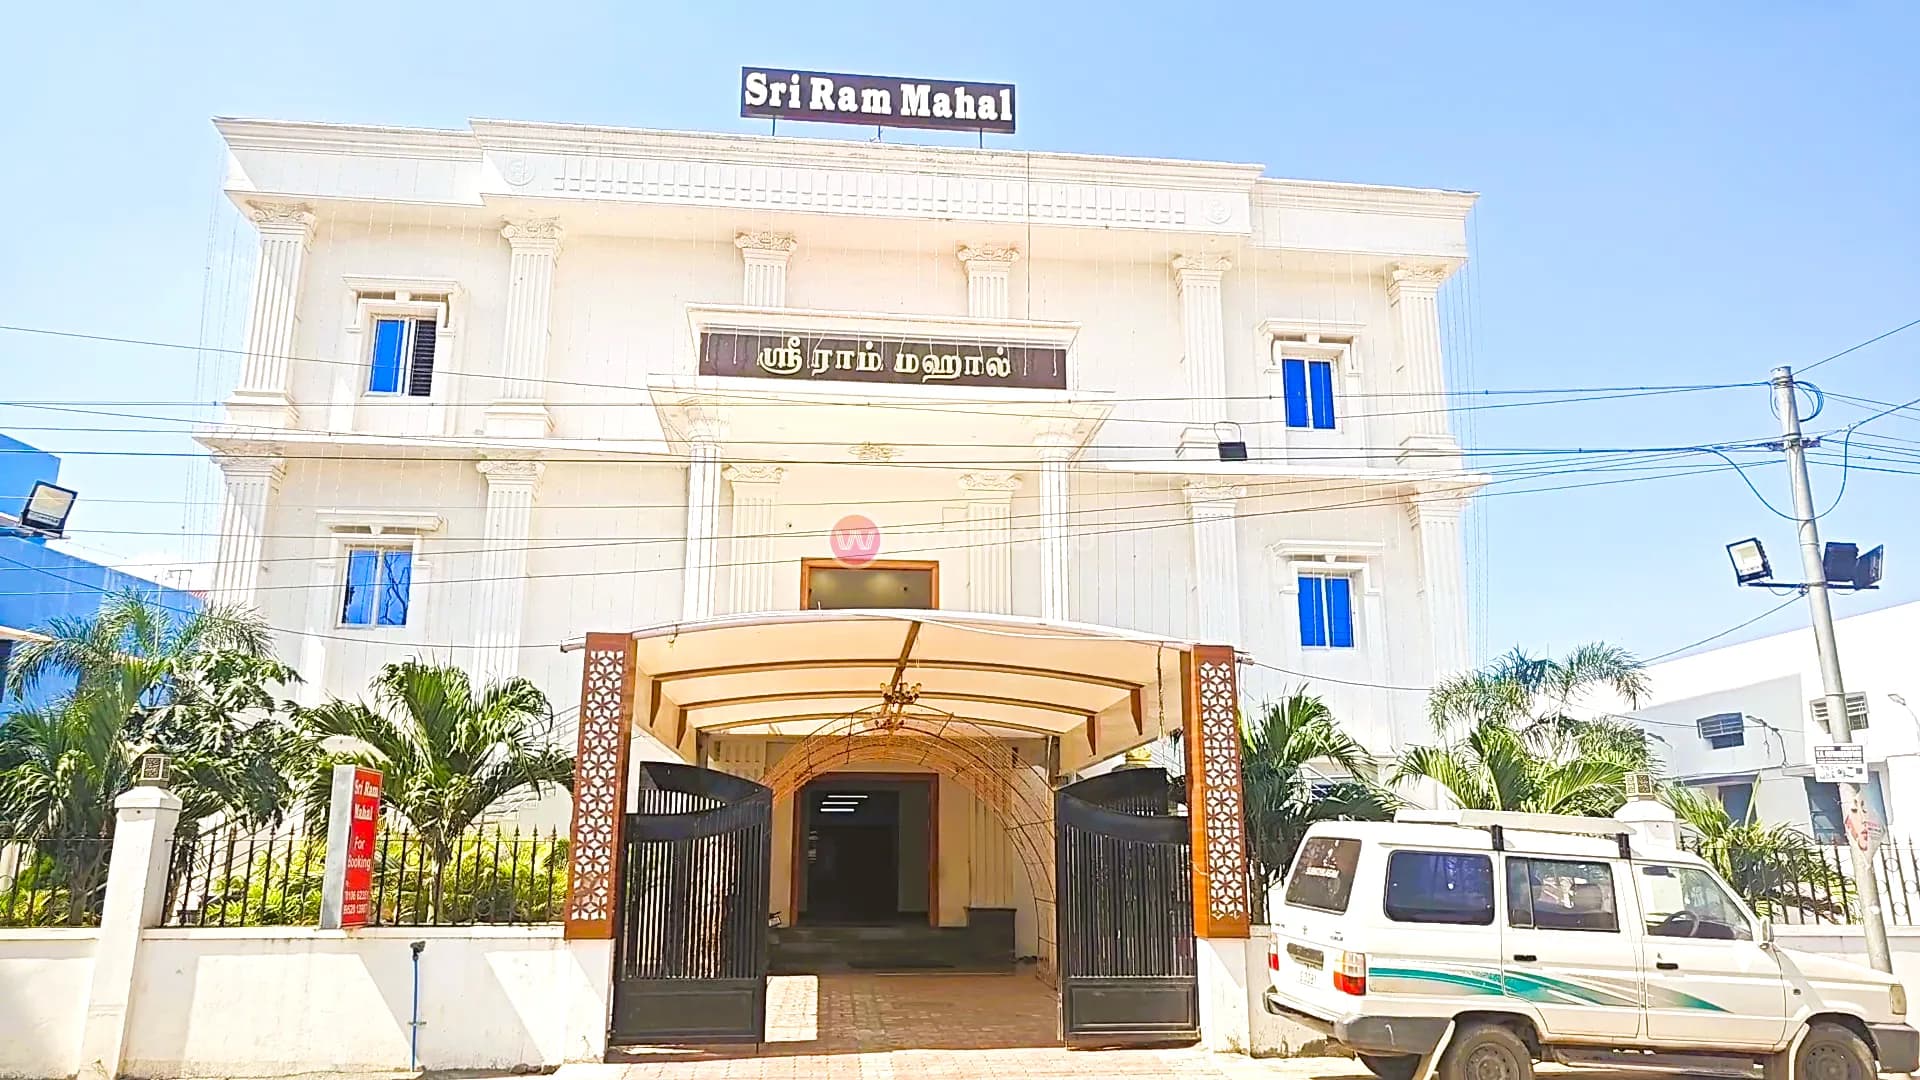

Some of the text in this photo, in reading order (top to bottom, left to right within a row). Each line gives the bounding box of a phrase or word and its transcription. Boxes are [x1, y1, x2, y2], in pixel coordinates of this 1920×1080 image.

[745, 71, 1013, 122] Sri Ram Mahal
[811, 342, 883, 376] ராம்
[893, 346, 1010, 383] மஹால்
[364, 781, 379, 798] Ram
